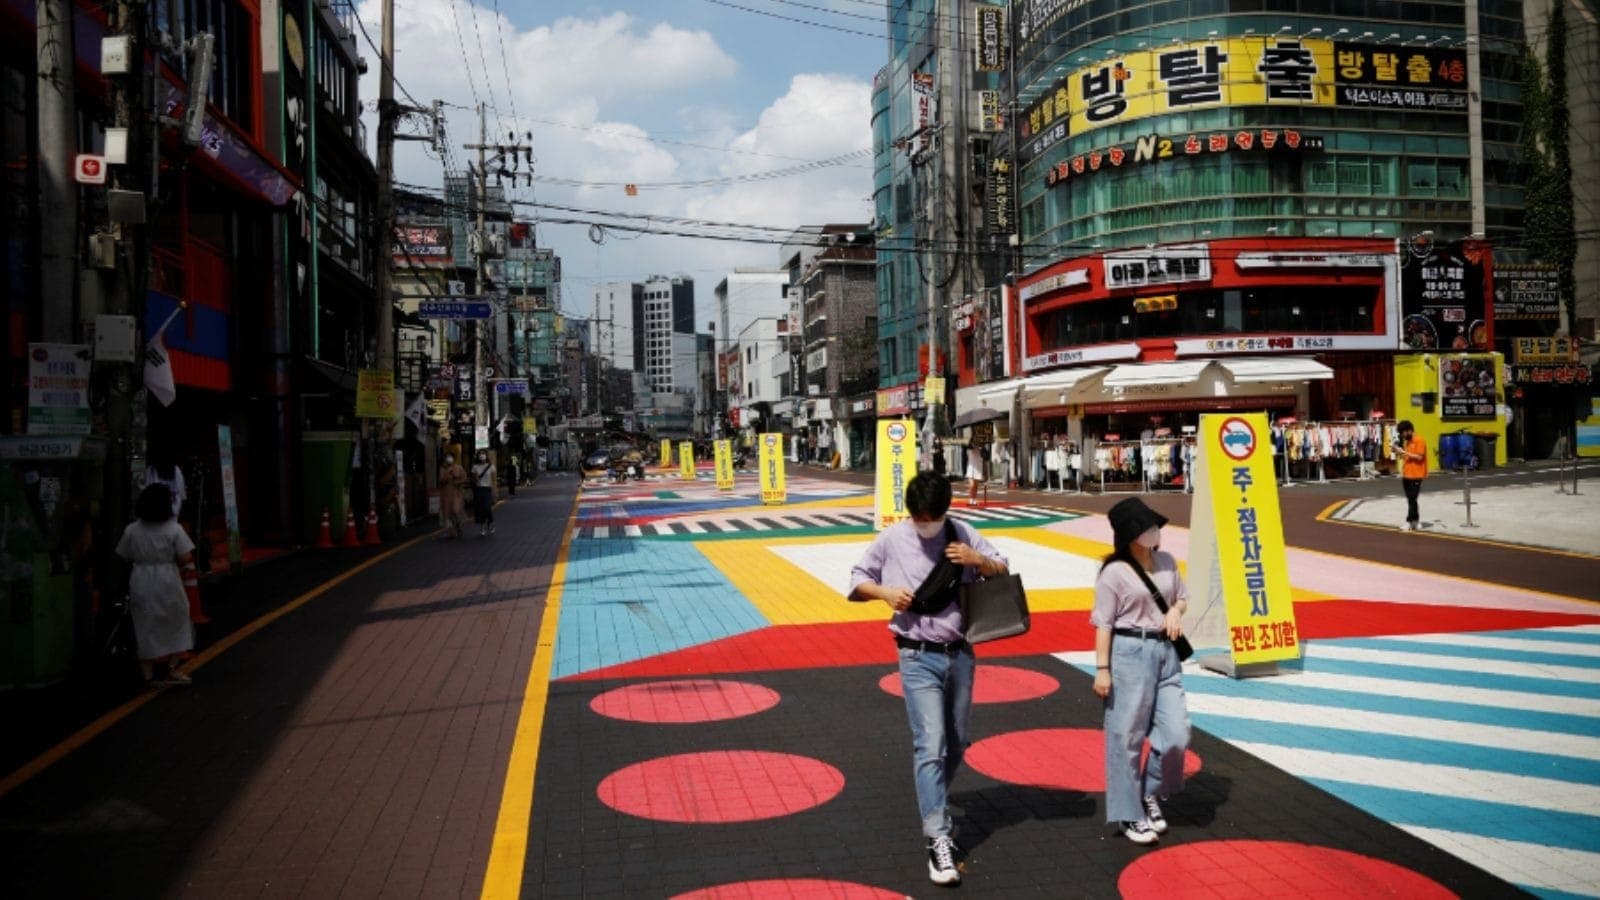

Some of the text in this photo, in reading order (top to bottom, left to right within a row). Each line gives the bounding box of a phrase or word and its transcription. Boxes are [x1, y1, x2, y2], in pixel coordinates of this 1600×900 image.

[1081, 41, 1317, 122] 방탈출
[1338, 51, 1465, 83] 방탈출 4층
[1233, 467, 1268, 616] 주·정차금지
[1231, 620, 1296, 653] 견인 조치함
